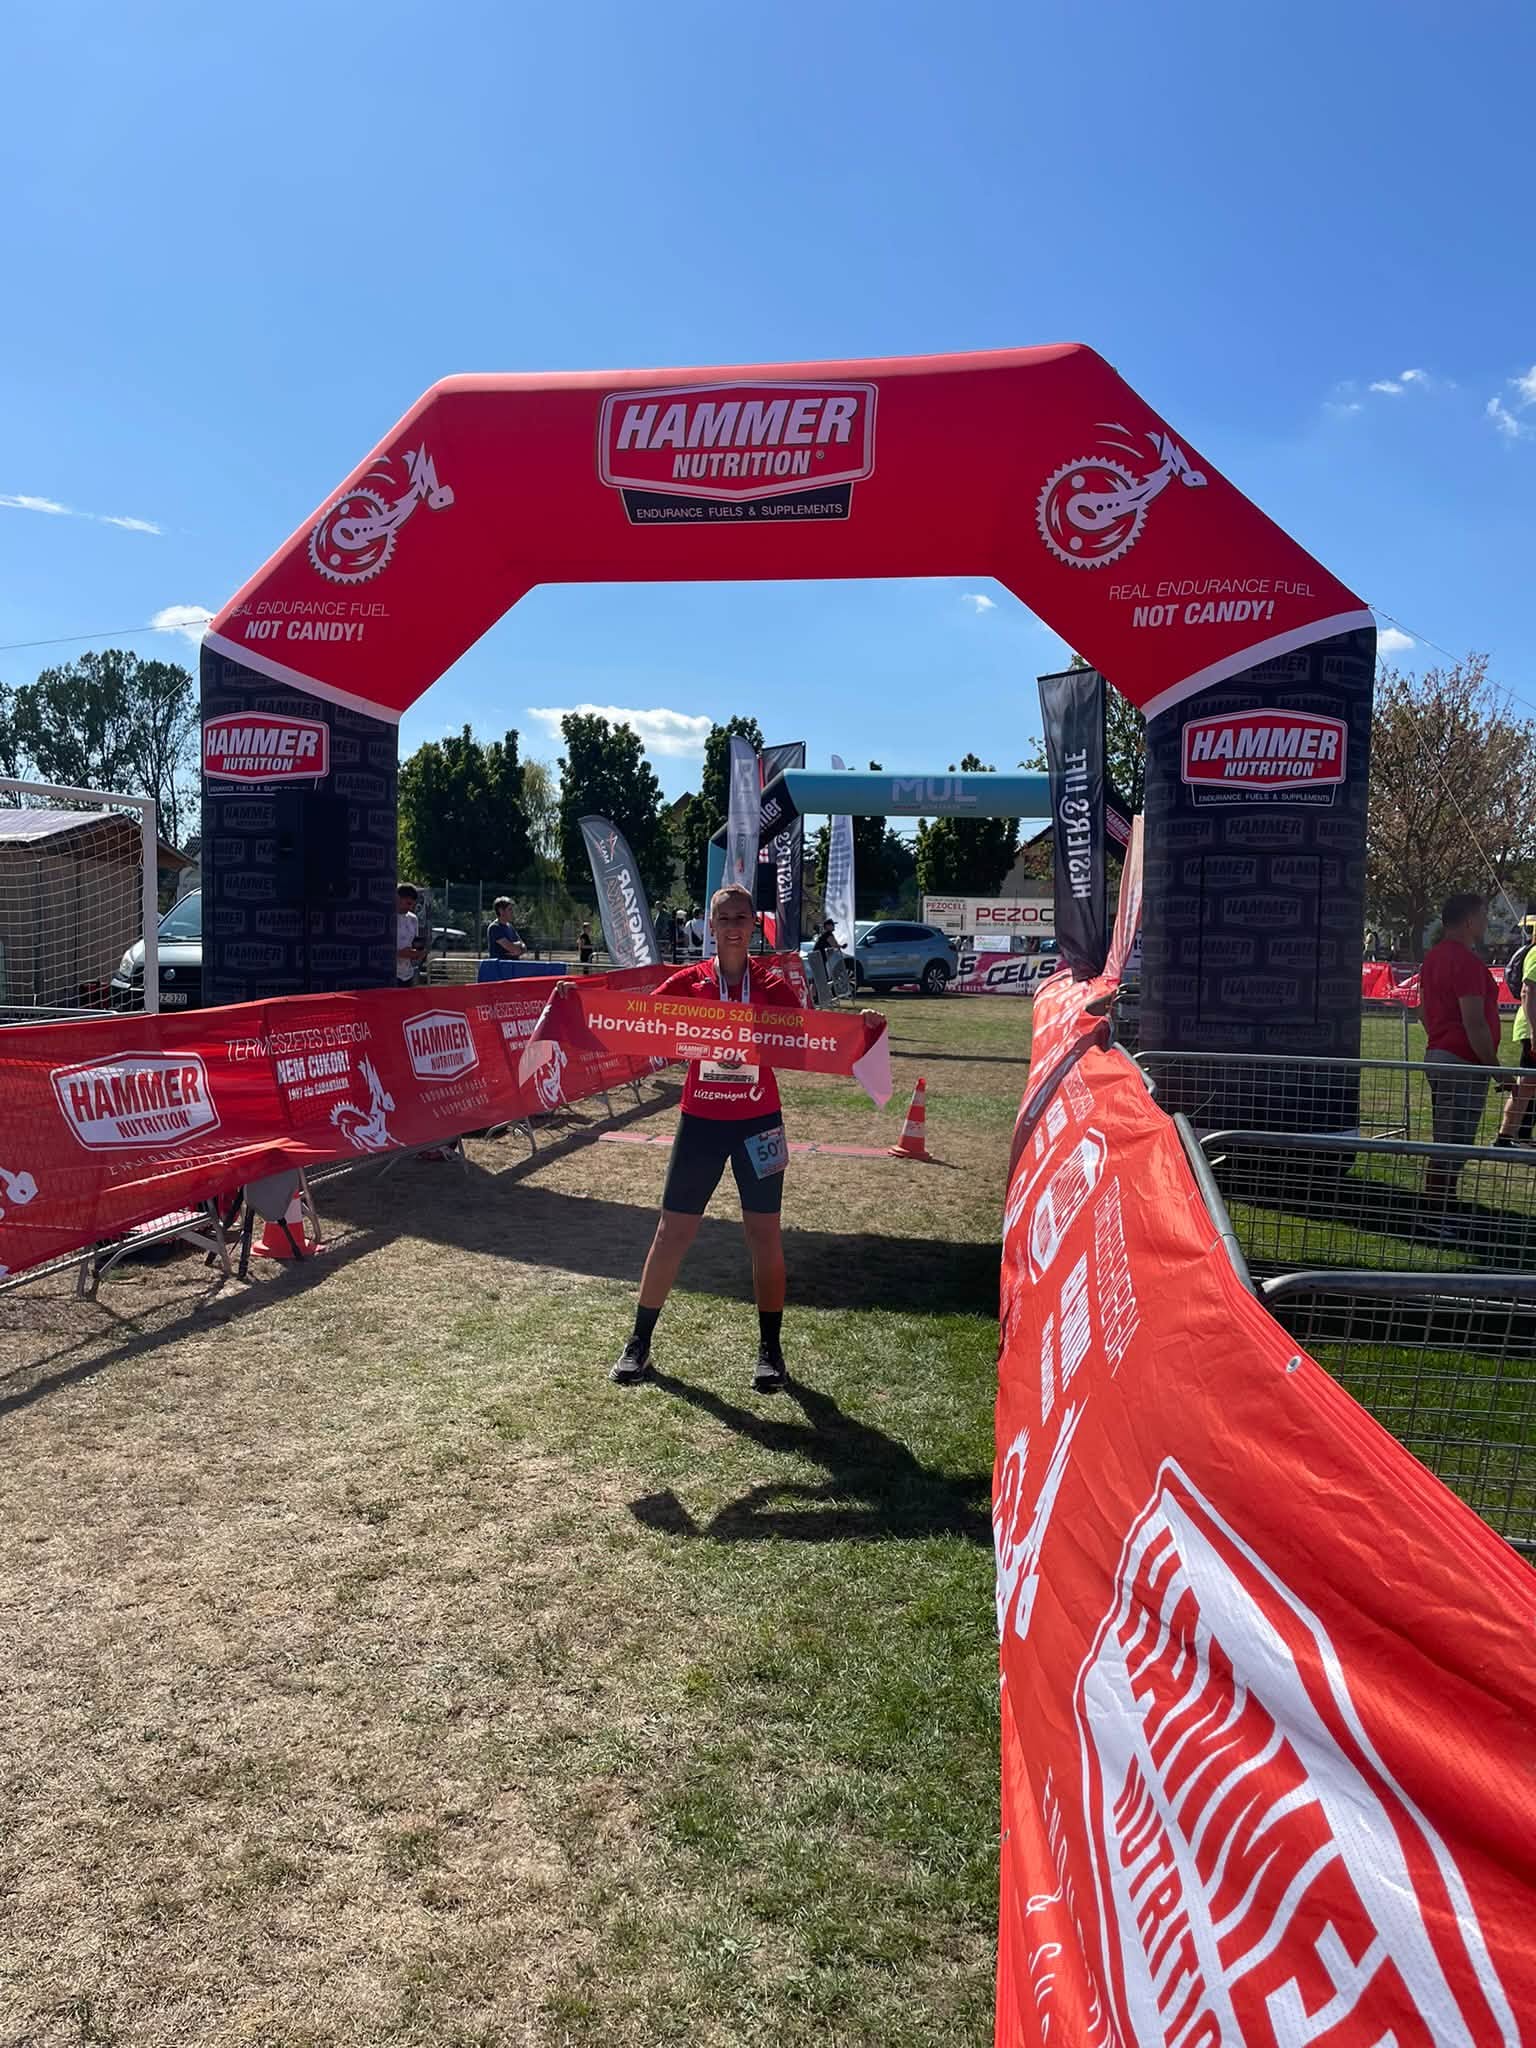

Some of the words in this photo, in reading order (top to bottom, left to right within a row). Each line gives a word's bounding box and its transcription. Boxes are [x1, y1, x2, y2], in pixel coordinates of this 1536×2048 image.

[616, 397, 858, 450] HAMMER
[672, 450, 811, 479] NUTRITION
[636, 507, 703, 519] ENDURANCE
[708, 506, 743, 517] FUELS
[747, 506, 757, 517] &
[761, 504, 843, 517] SUPPLEMENTS
[1109, 584, 1151, 600] REAL
[1156, 579, 1271, 597] ENDURANCE
[1274, 581, 1316, 597] FUEL
[256, 601, 347, 617] ENDURANCE
[350, 602, 391, 617] FUEL
[1132, 604, 1180, 627] NOT
[1184, 600, 1275, 626] CANDY!
[244, 620, 283, 640] NOT
[286, 621, 365, 641] CANDY!
[206, 728, 320, 758] HAMMER
[1191, 727, 1340, 762] HAMMER
[222, 757, 294, 771] NUTRITION
[1223, 761, 1315, 777] NUTRITION
[892, 778, 977, 802] MUL
[1199, 793, 1242, 802] ENDURANCE
[1245, 793, 1270, 801] FUELS
[1281, 792, 1331, 802] SUPPLEMENTS
[926, 902, 967, 911] PEZOCELL
[626, 1000, 649, 1013] XIII.
[653, 1002, 726, 1020] PEZOWOOD
[225, 1028, 323, 1062] TERMÉSZETES
[323, 1021, 373, 1046] ENERGIA
[410, 1023, 470, 1057] HAMMER
[587, 1013, 734, 1040] Horváth-Bozsó
[738, 1028, 838, 1052] Bernadett
[711, 1046, 749, 1062] 50K
[276, 1057, 307, 1084] NEM
[307, 1050, 351, 1079] CUKOR!
[69, 1066, 201, 1122] HAMMER
[115, 1110, 192, 1139] NUTRITION
